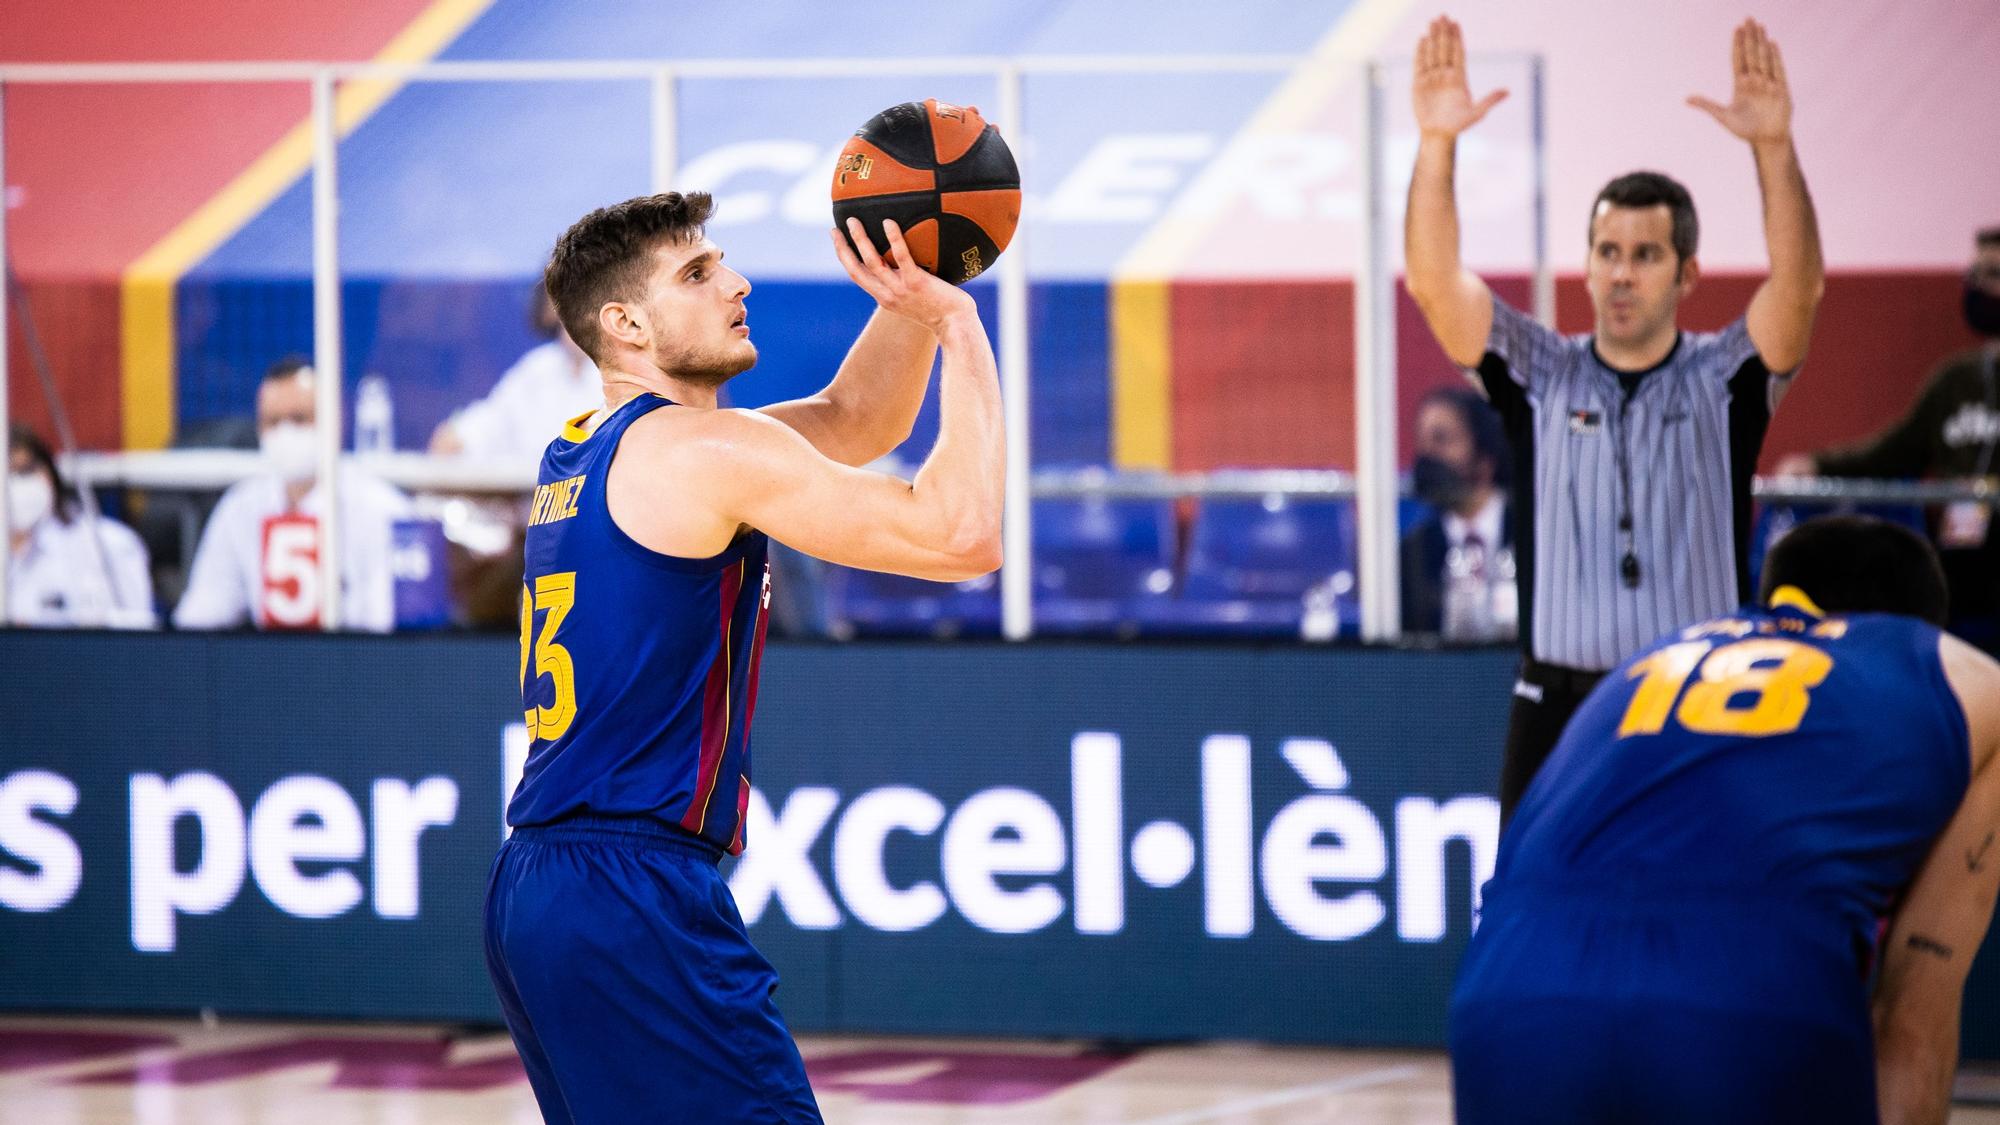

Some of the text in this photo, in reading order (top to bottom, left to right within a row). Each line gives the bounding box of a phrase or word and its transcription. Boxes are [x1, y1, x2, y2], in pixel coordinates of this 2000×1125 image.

[269, 525, 319, 622] 5
[1617, 637, 1834, 738] 18
[128, 772, 459, 952] per
